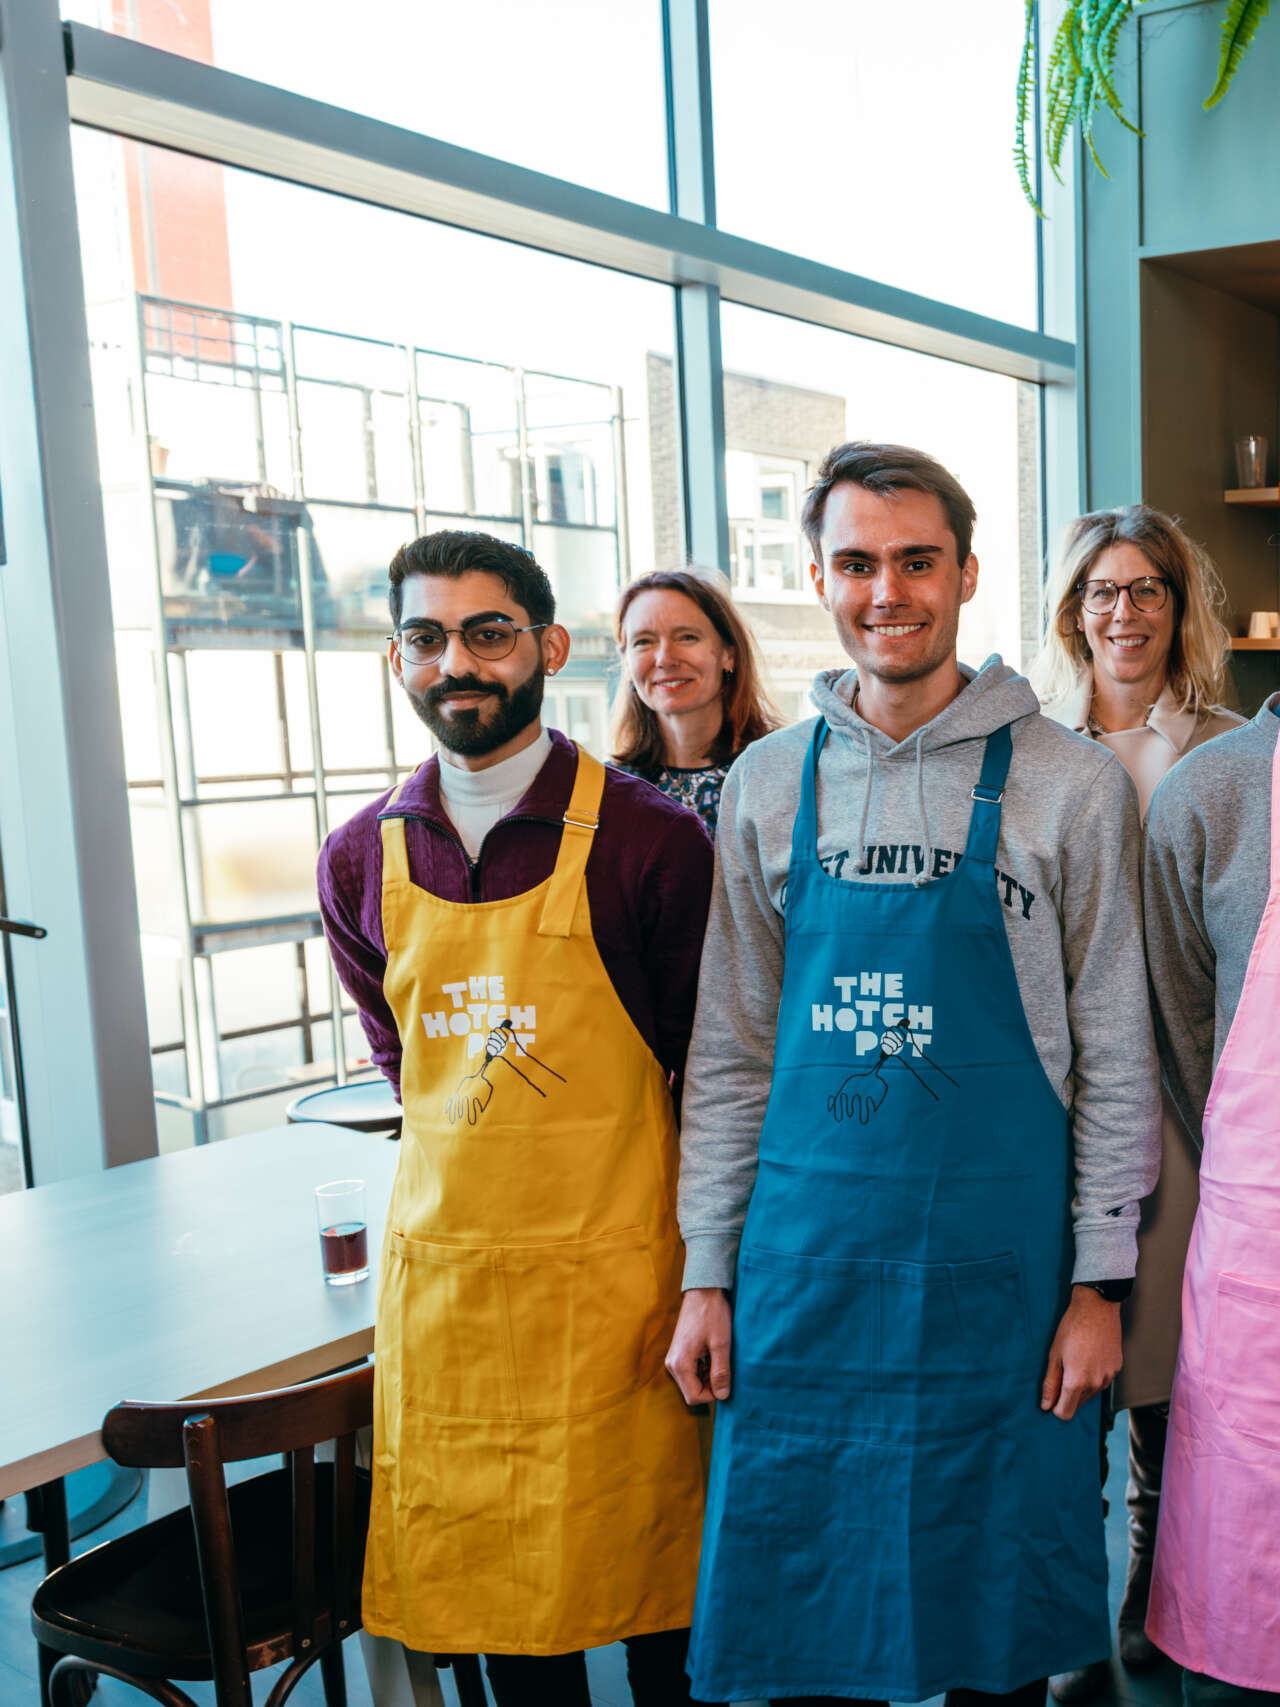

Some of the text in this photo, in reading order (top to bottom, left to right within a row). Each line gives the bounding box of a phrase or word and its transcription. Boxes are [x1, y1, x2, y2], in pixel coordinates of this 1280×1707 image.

[860, 845, 1035, 920] UNIVETY
[441, 975, 505, 1008] THE
[834, 972, 904, 1003] THE
[421, 1003, 536, 1038] HOTCH
[812, 1000, 933, 1031] HOTCH
